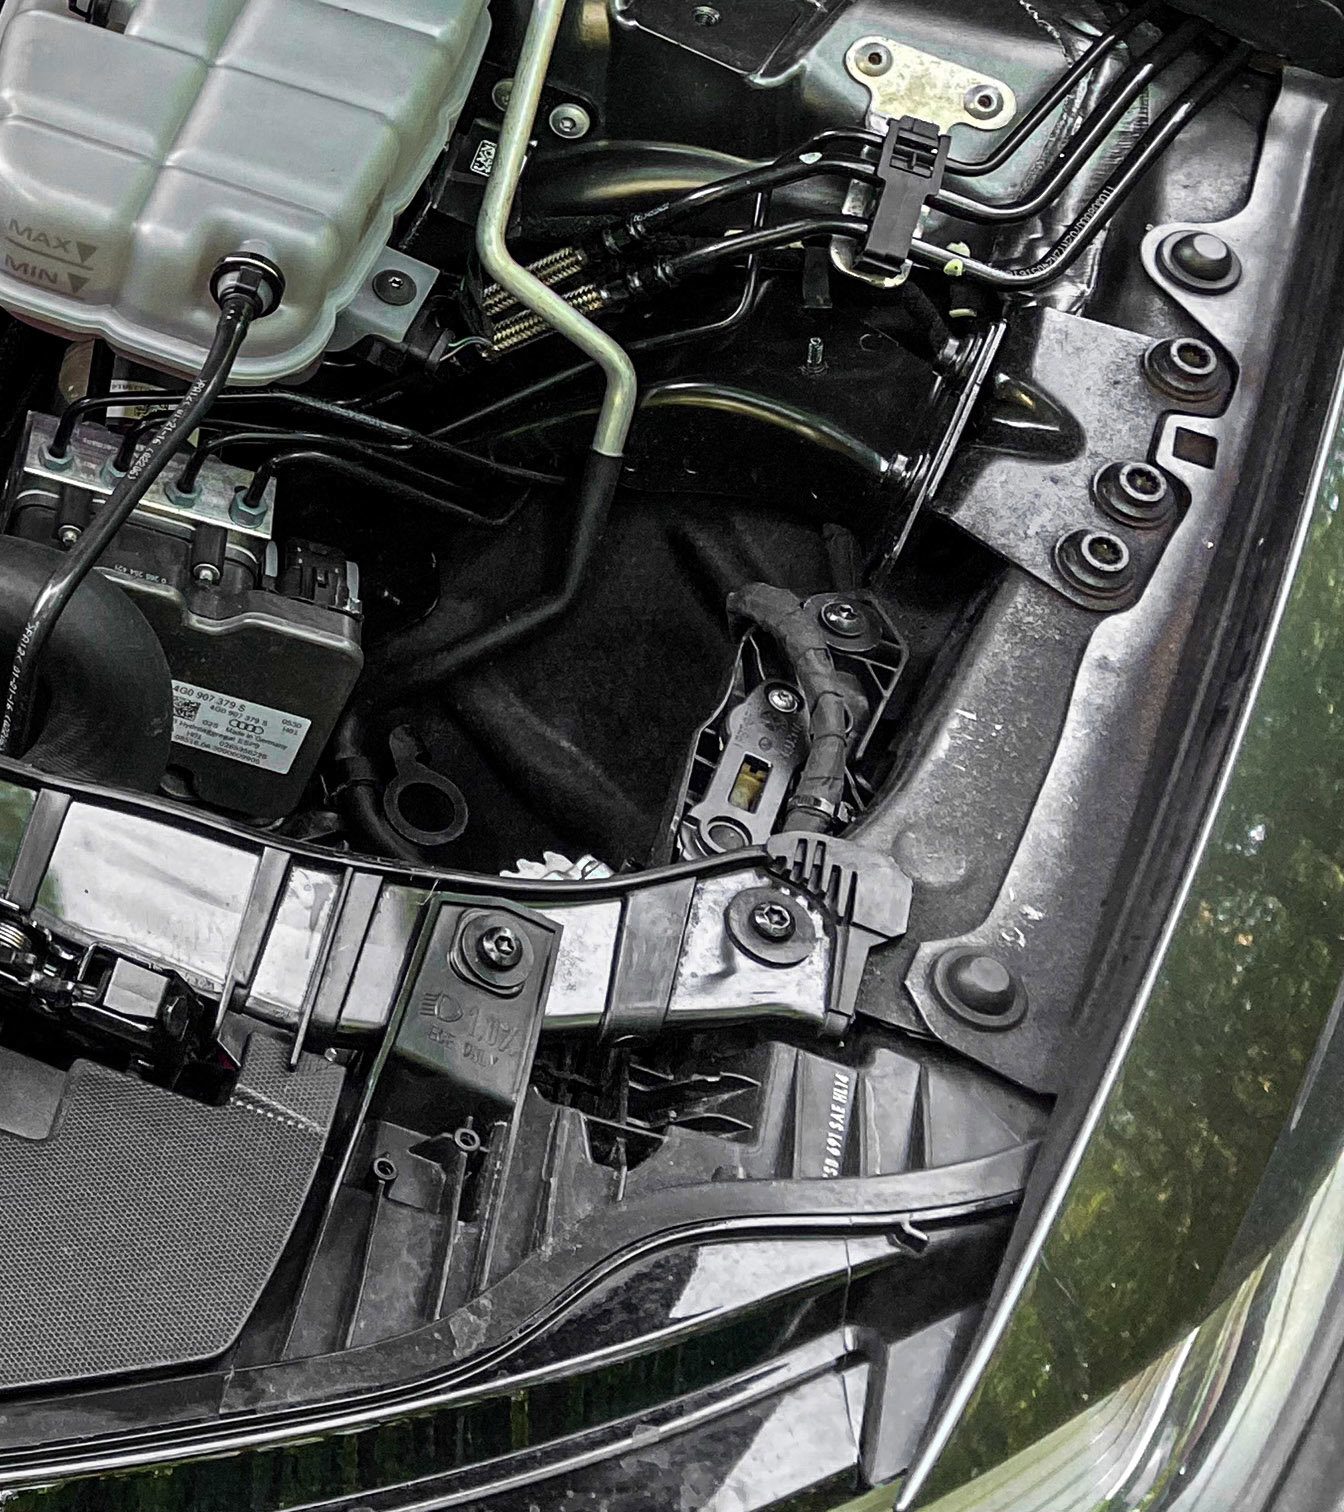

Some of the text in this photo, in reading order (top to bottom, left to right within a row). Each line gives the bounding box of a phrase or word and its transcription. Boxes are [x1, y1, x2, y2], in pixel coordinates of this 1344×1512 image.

[8, 217, 72, 254] MAX
[4, 253, 59, 285] MIN
[173, 684, 247, 713] 4G0 907 379 S
[254, 734, 289, 751] Germany
[826, 1103, 849, 1132] SAE
